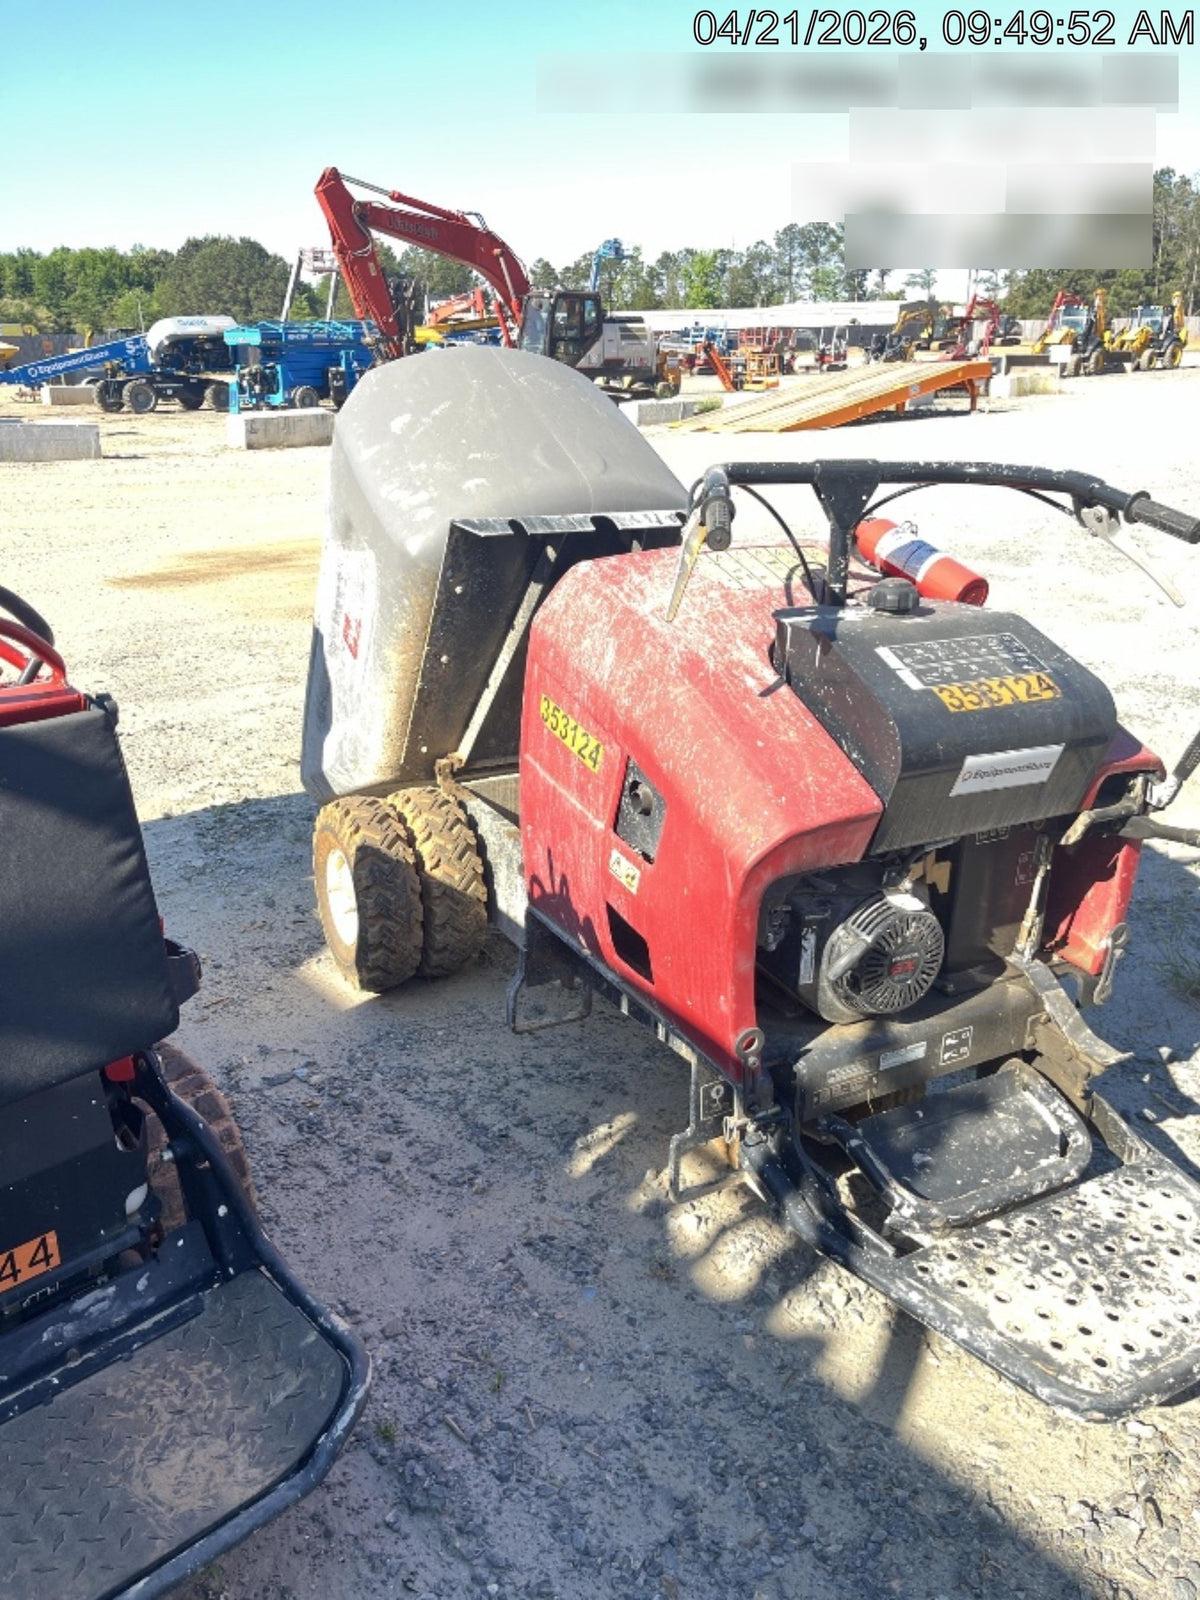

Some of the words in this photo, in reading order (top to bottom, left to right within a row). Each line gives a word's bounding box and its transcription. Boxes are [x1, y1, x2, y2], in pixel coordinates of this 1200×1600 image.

[938, 675, 1056, 710] 353124
[541, 696, 601, 769] 353124
[0, 1236, 54, 1283] 44
